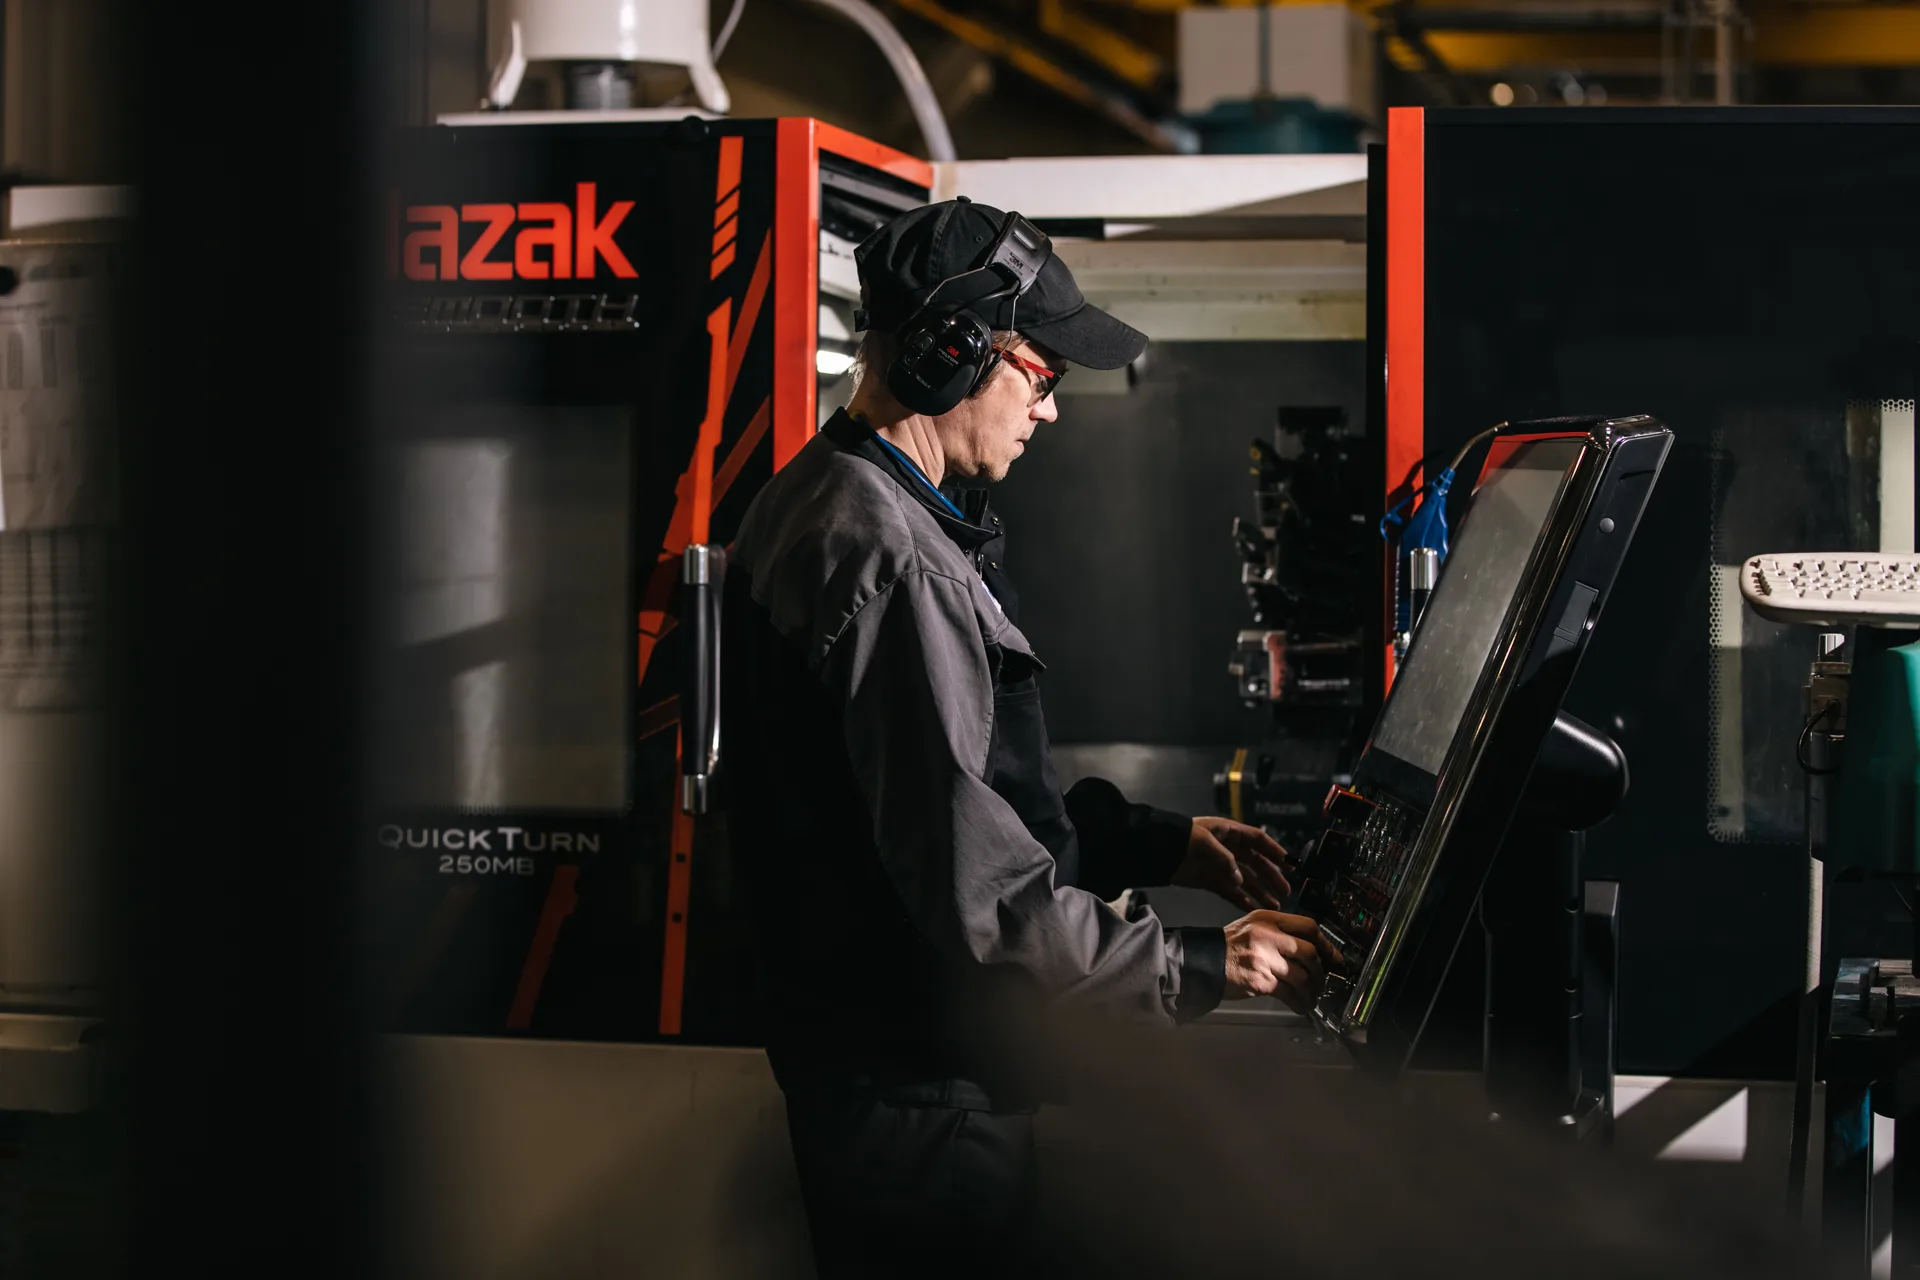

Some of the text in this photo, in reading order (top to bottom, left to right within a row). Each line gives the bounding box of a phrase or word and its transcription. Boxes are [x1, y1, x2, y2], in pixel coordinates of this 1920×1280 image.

[1009, 256, 1024, 270] 3M
[403, 294, 640, 333] MOOTH
[946, 345, 959, 358] 3M
[378, 824, 600, 853] QUICK TURN
[439, 855, 535, 876] 250MB
